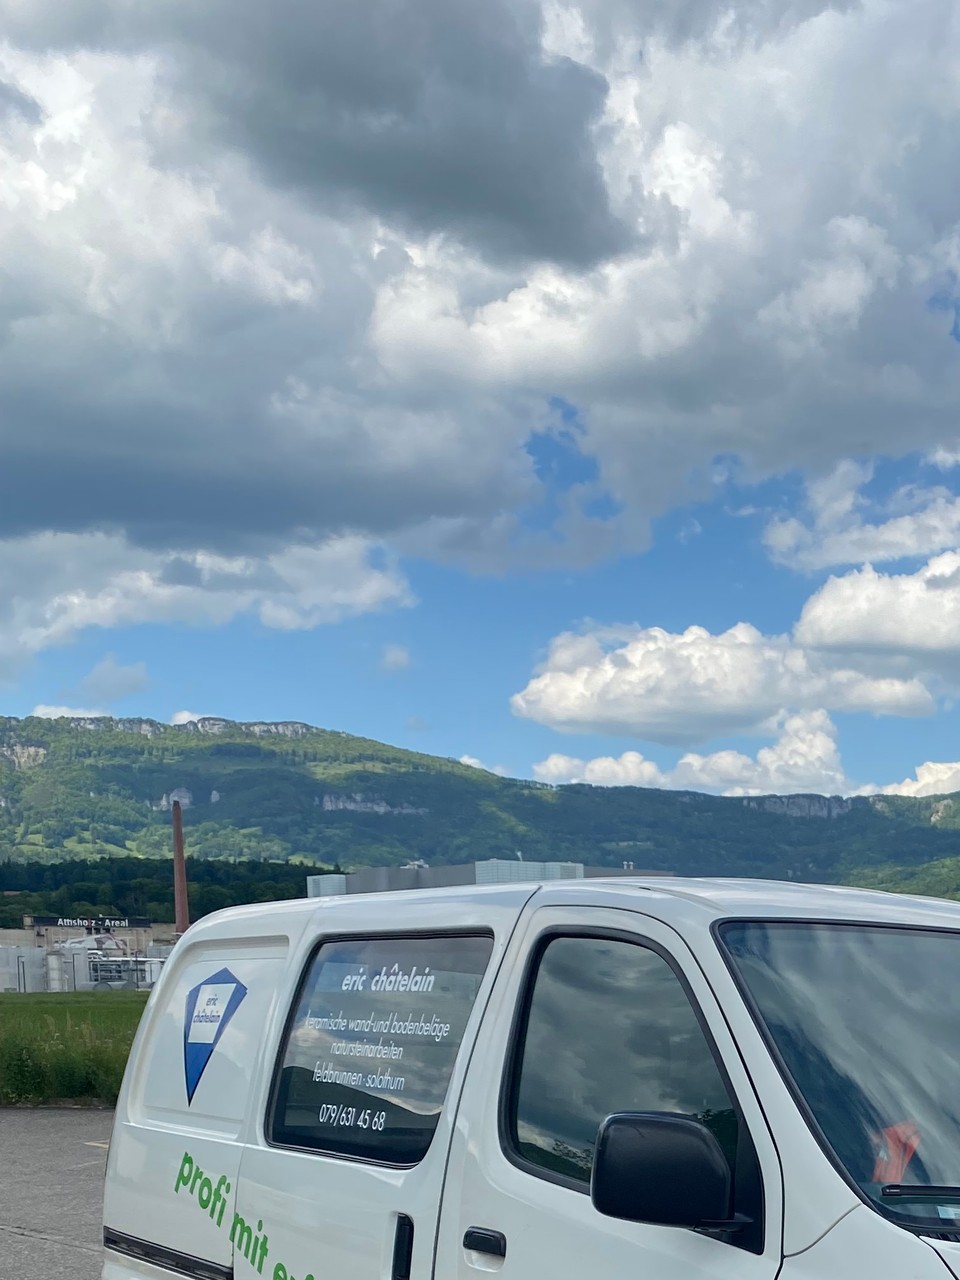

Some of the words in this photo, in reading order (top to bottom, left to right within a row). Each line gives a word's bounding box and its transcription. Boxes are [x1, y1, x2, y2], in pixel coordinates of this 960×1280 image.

[104, 918, 129, 927] Areal
[341, 967, 364, 991] eric
[371, 963, 435, 992] châtelain
[305, 1009, 347, 1031] keramische
[390, 1012, 450, 1042] bodenbeläge
[330, 1037, 404, 1060] natursteinarbeiten
[365, 1067, 405, 1091] solothurn
[319, 1103, 356, 1127] 079/631
[356, 1109, 372, 1129] 45
[372, 1111, 386, 1131] 68
[174, 1151, 231, 1228] profi
[229, 1211, 269, 1275] mit
